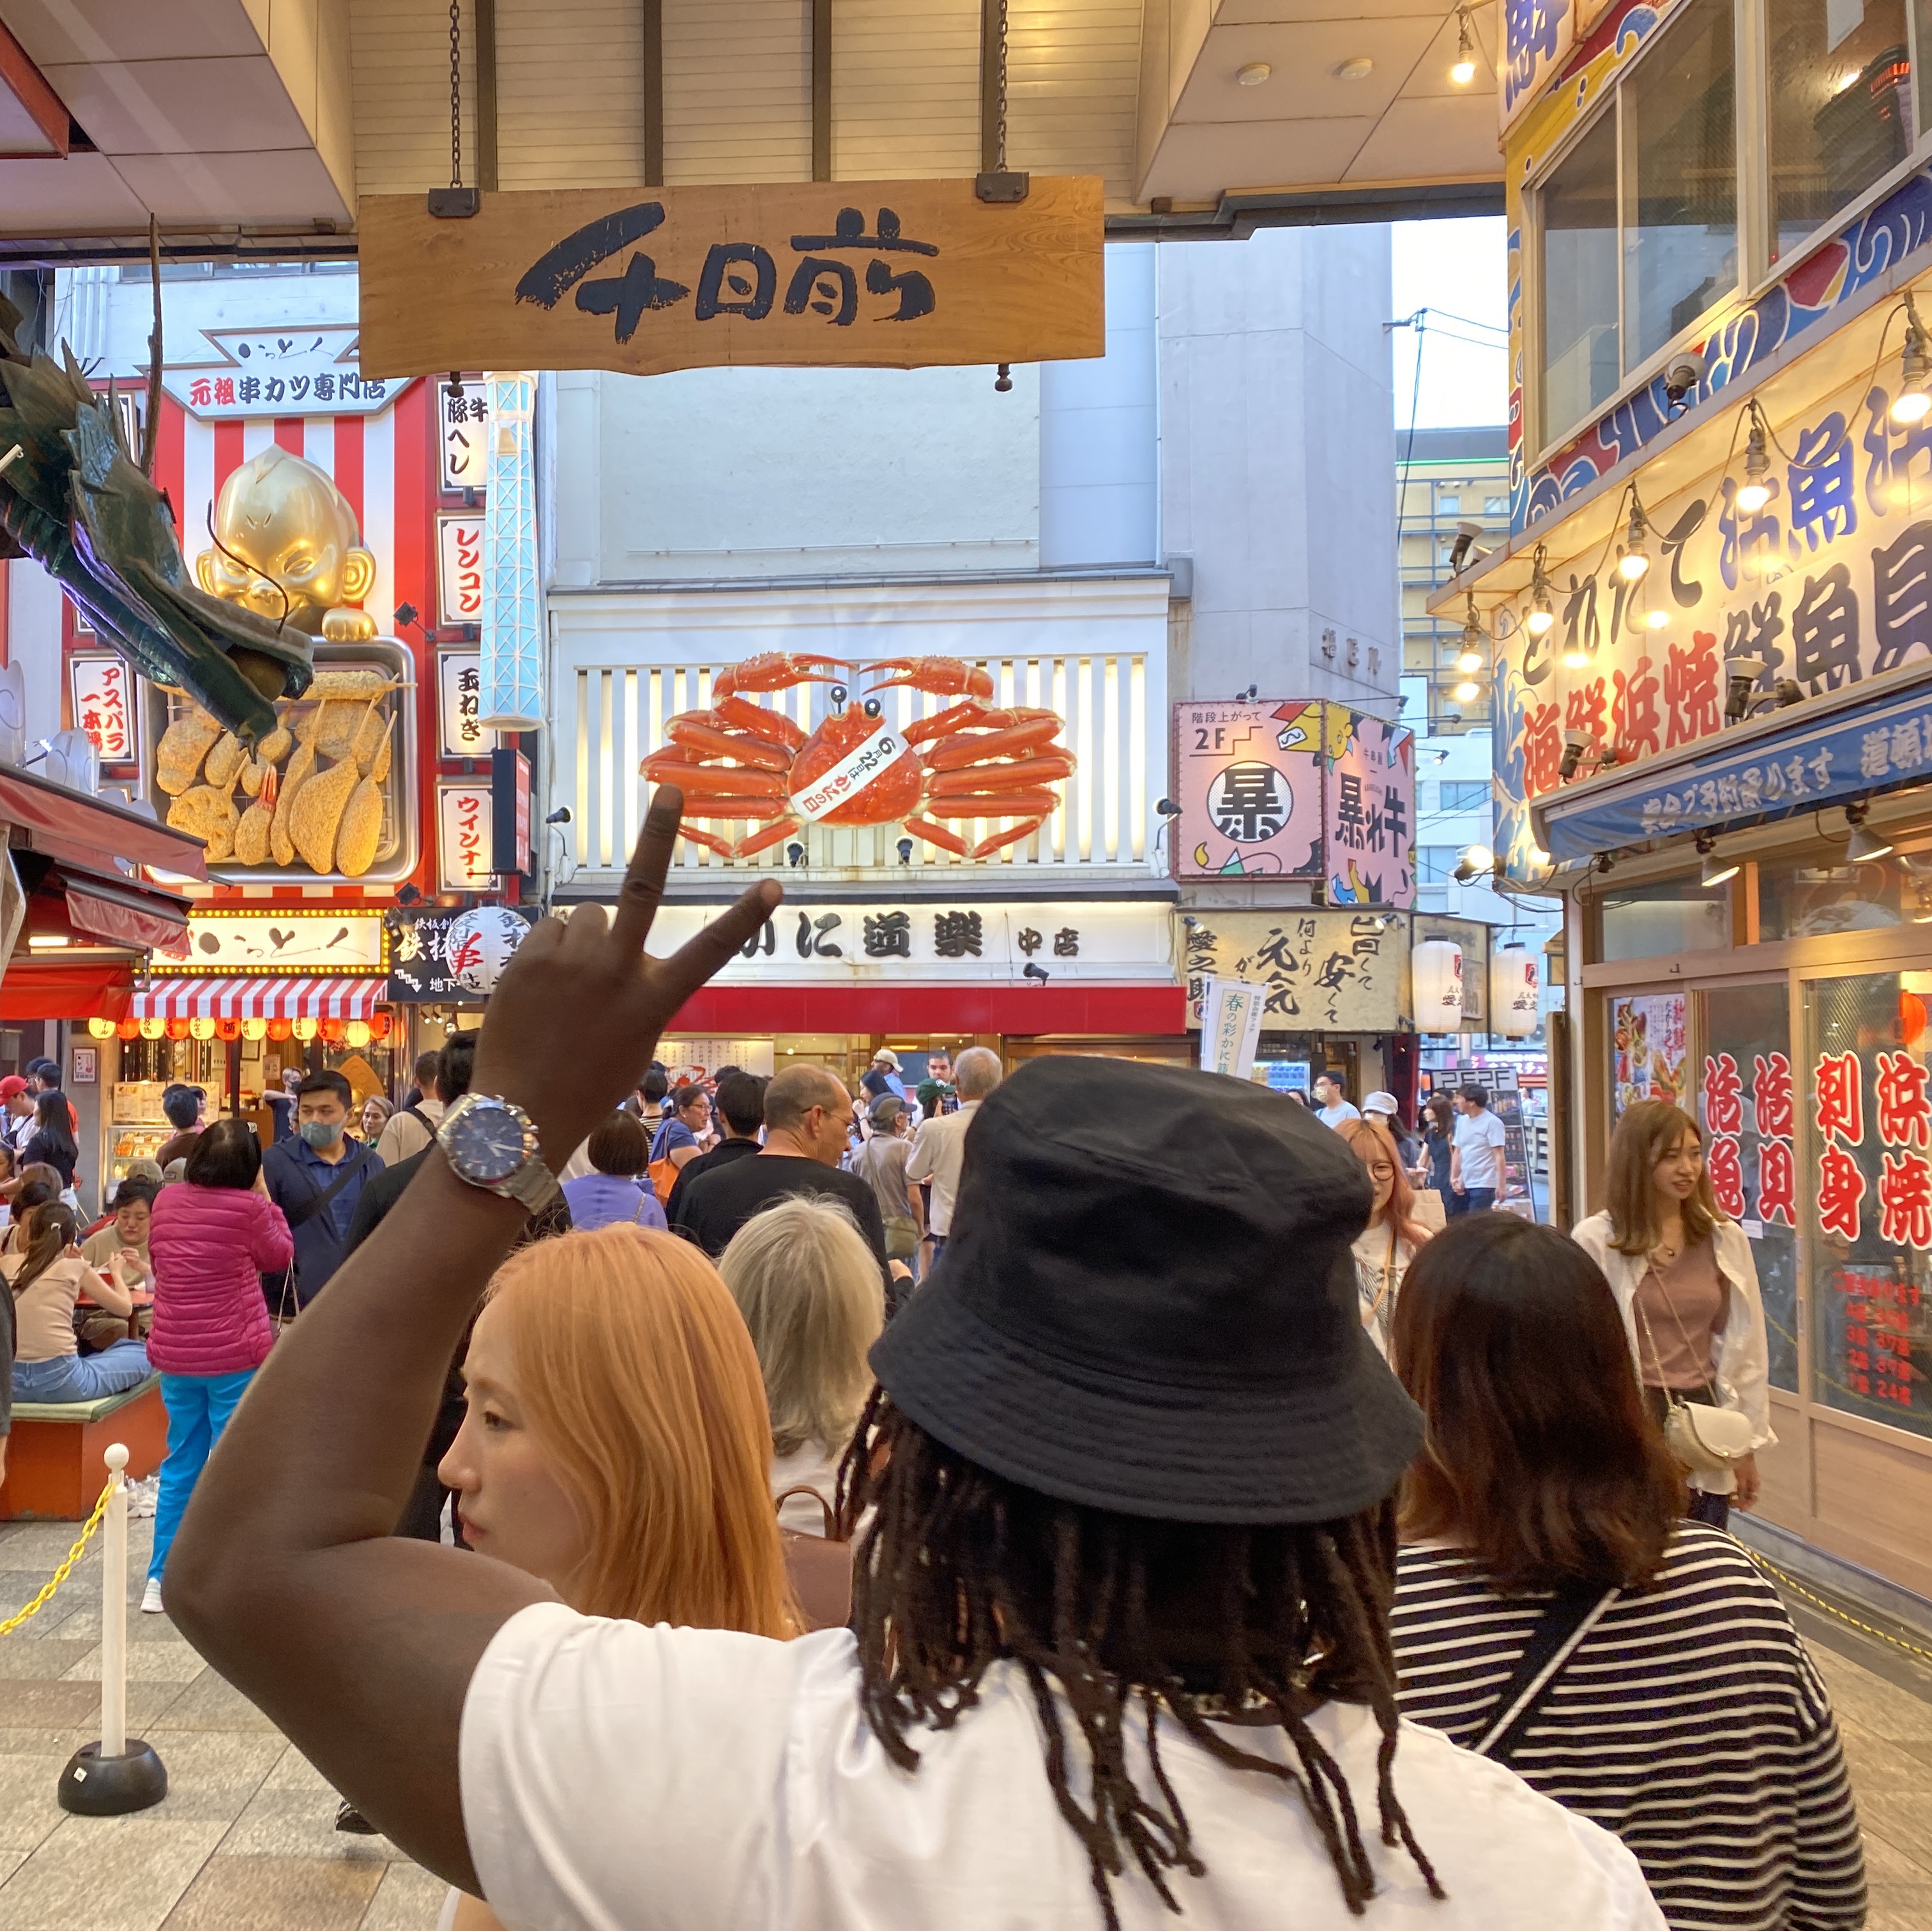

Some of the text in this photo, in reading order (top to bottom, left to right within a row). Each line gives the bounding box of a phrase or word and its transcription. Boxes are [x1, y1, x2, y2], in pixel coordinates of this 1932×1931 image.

[515, 201, 939, 344] 千日前
[190, 372, 386, 406] 元祖串カツ専門店
[457, 527, 481, 613] レンコン
[102, 667, 125, 752] アスパラ
[457, 667, 481, 741] 玉ねぎ
[1192, 711, 1262, 724] 階段上がって
[1195, 727, 1226, 750] 2F
[802, 736, 896, 813] 6月22日はかにの日
[457, 797, 481, 879] ウインナー
[1018, 927, 1079, 957] 中店
[1235, 956, 1255, 984] が
[1256, 928, 1300, 1015] 元気
[1297, 918, 1316, 976] 何より
[1314, 951, 1355, 1024] 安くて
[1705, 1052, 1745, 1220] 活魚
[1814, 1050, 1866, 1241] 刺身
[1875, 1050, 1932, 1250] 浜焼
